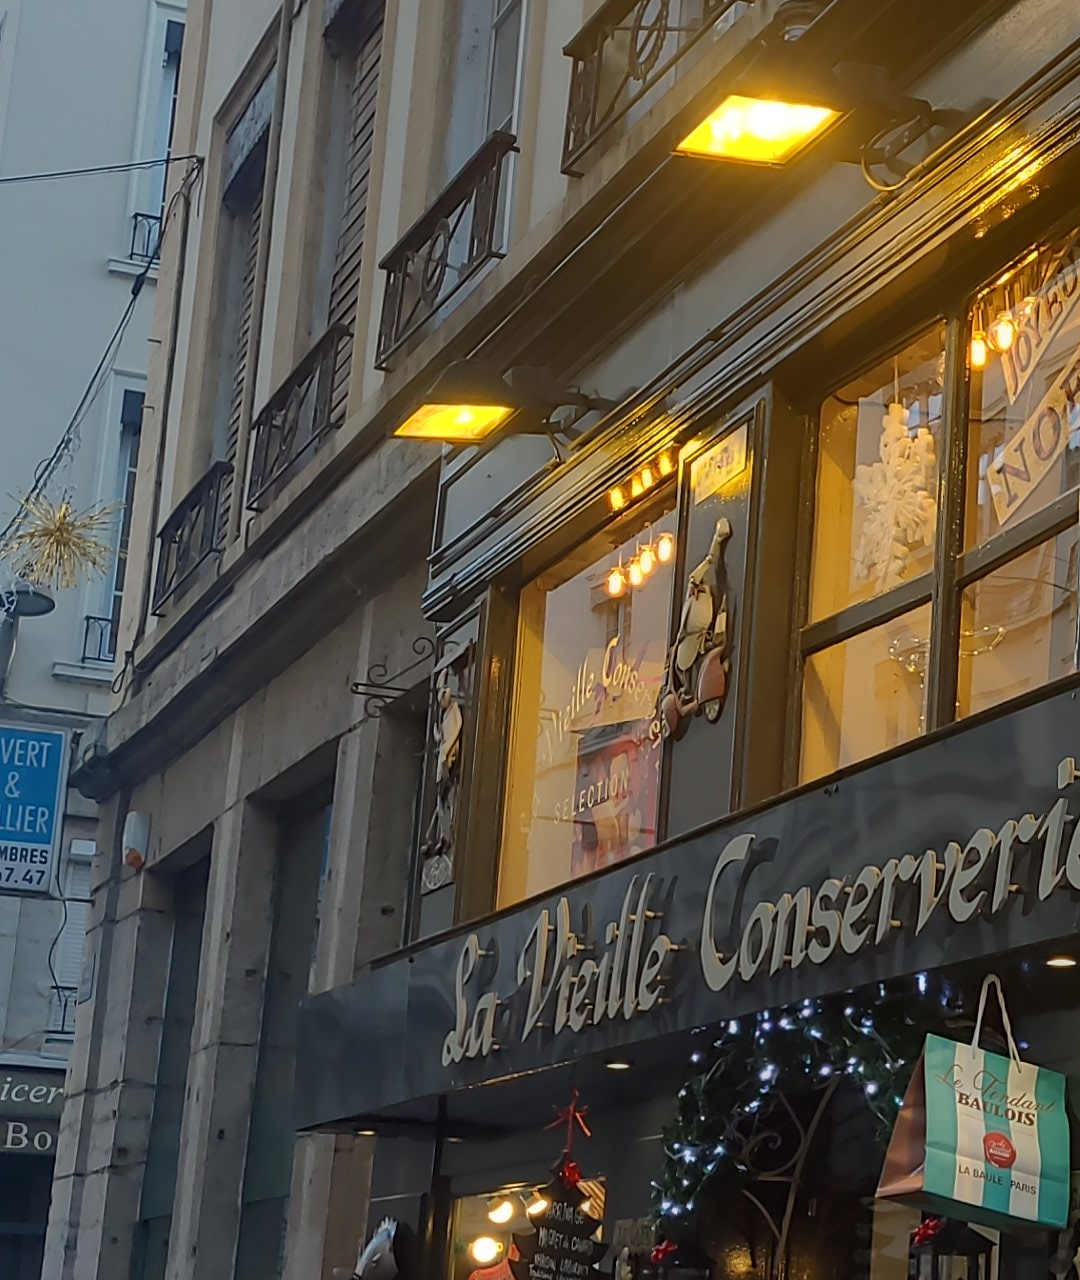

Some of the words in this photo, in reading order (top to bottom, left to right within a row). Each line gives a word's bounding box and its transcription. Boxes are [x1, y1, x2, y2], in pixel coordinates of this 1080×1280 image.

[5, 772, 20, 798] &
[554, 768, 629, 825] SELECTION
[0, 867, 45, 885] 7.47
[441, 933, 498, 1068] La
[518, 872, 670, 1043] Vieille
[935, 1063, 971, 1097] Le
[973, 1070, 1056, 1115] Fondant
[957, 1091, 1036, 1127] BAULOIS
[958, 1164, 971, 1176] LA
[973, 1167, 1004, 1186] BAULE
[1010, 1179, 1037, 1196] PARIS
